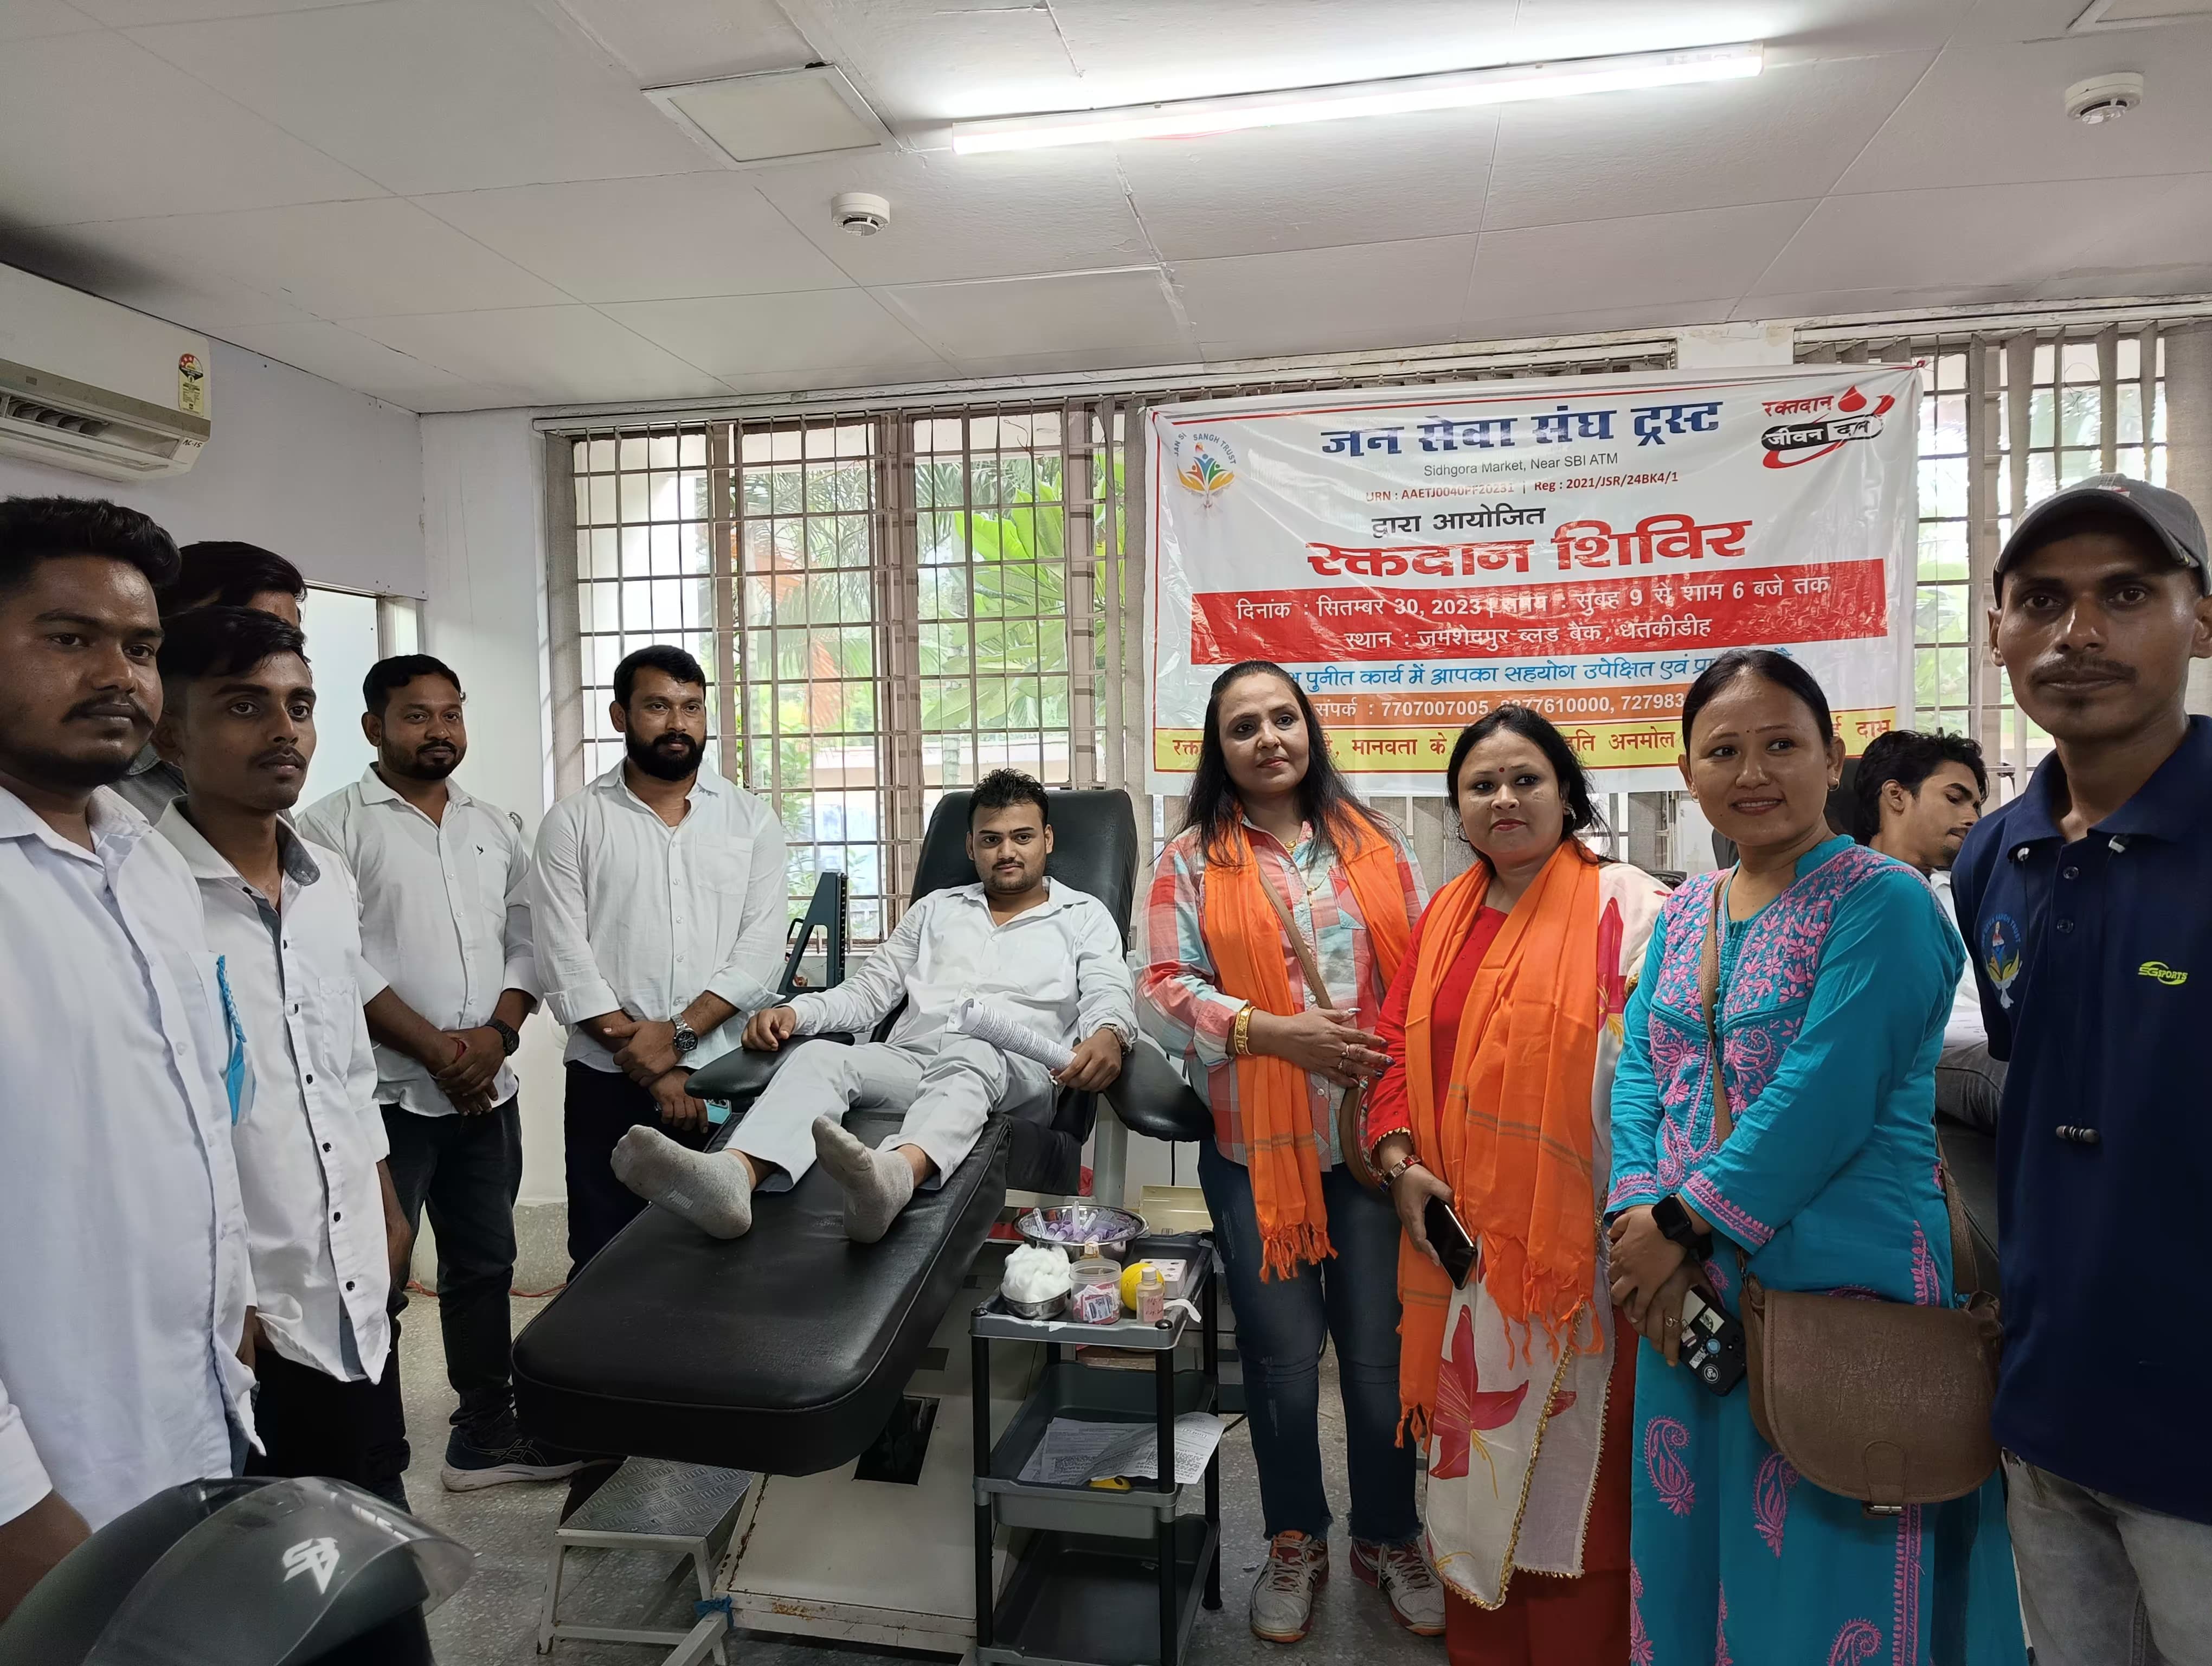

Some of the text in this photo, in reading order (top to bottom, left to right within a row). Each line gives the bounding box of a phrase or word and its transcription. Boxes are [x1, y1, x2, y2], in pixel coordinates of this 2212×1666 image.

[1761, 396, 1835, 416] रक्तदान
[1321, 401, 1724, 457] जन सेवा संघ ट्रस्ट
[1765, 428, 1824, 445] जीवन
[1193, 433, 1220, 444] SANGH
[1220, 440, 1236, 464] TRUST
[1424, 452, 1618, 477] Sidhgora Market, Near SBI ATM
[1366, 491, 1391, 502] URN
[1534, 482, 1555, 492] Reg
[1566, 471, 1679, 489] 2021/JSR/24BK4/1
[1371, 503, 1546, 538] द्वारा आयोजित
[1306, 514, 1753, 577] रक्तदान शिविर
[1235, 598, 1293, 620] दिनांक
[1316, 594, 1386, 617] सितम्बर
[1394, 598, 1424, 617] 30,
[1431, 598, 1482, 615] 2023
[1576, 591, 1620, 616] सुबह
[1630, 588, 1643, 606] 9
[1681, 583, 1724, 601] शाम
[1733, 581, 1745, 599] 6
[1752, 574, 1785, 597] बजे
[1792, 576, 1831, 595] तक
[1343, 632, 1392, 648] स्थान
[1417, 624, 1510, 651] जमशेदपुर
[1517, 627, 1560, 643] ब्लड
[1306, 665, 1355, 693] पुनीत
[1360, 664, 1405, 685] कार्य
[1409, 663, 1426, 685] में
[1431, 668, 1500, 685] आपका
[1504, 659, 1577, 683] सहयोग
[1583, 657, 1656, 680] उपेक्षित
[1660, 653, 1690, 680] एवं
[1315, 697, 1358, 717] संपर्क
[1352, 738, 1418, 755] मानवता
[1430, 732, 1448, 755] के
[1609, 726, 1676, 750] अनमोल
